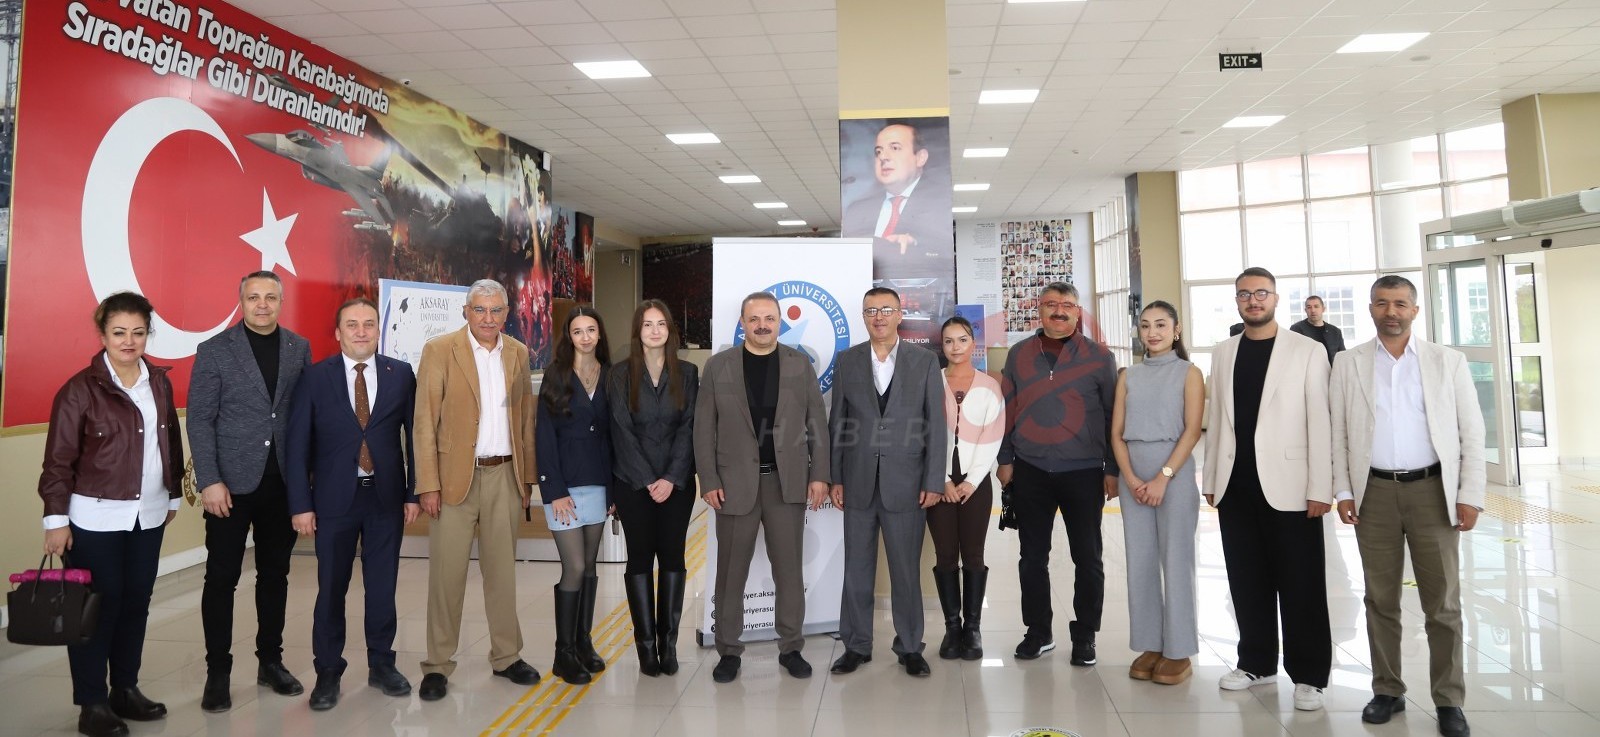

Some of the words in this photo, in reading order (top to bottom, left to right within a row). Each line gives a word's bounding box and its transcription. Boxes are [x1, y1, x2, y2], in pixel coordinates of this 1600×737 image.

[62, 2, 205, 80] Sıradağlar
[207, 56, 252, 98] Gibi
[252, 73, 367, 138] Duranlarındır!
[198, 7, 286, 71] Toprağın
[288, 49, 389, 114] Karabağrında
[1223, 55, 1249, 67] EXIT
[419, 297, 450, 311] AKSARAY
[782, 283, 849, 339] ÜNİVERSİTESİ
